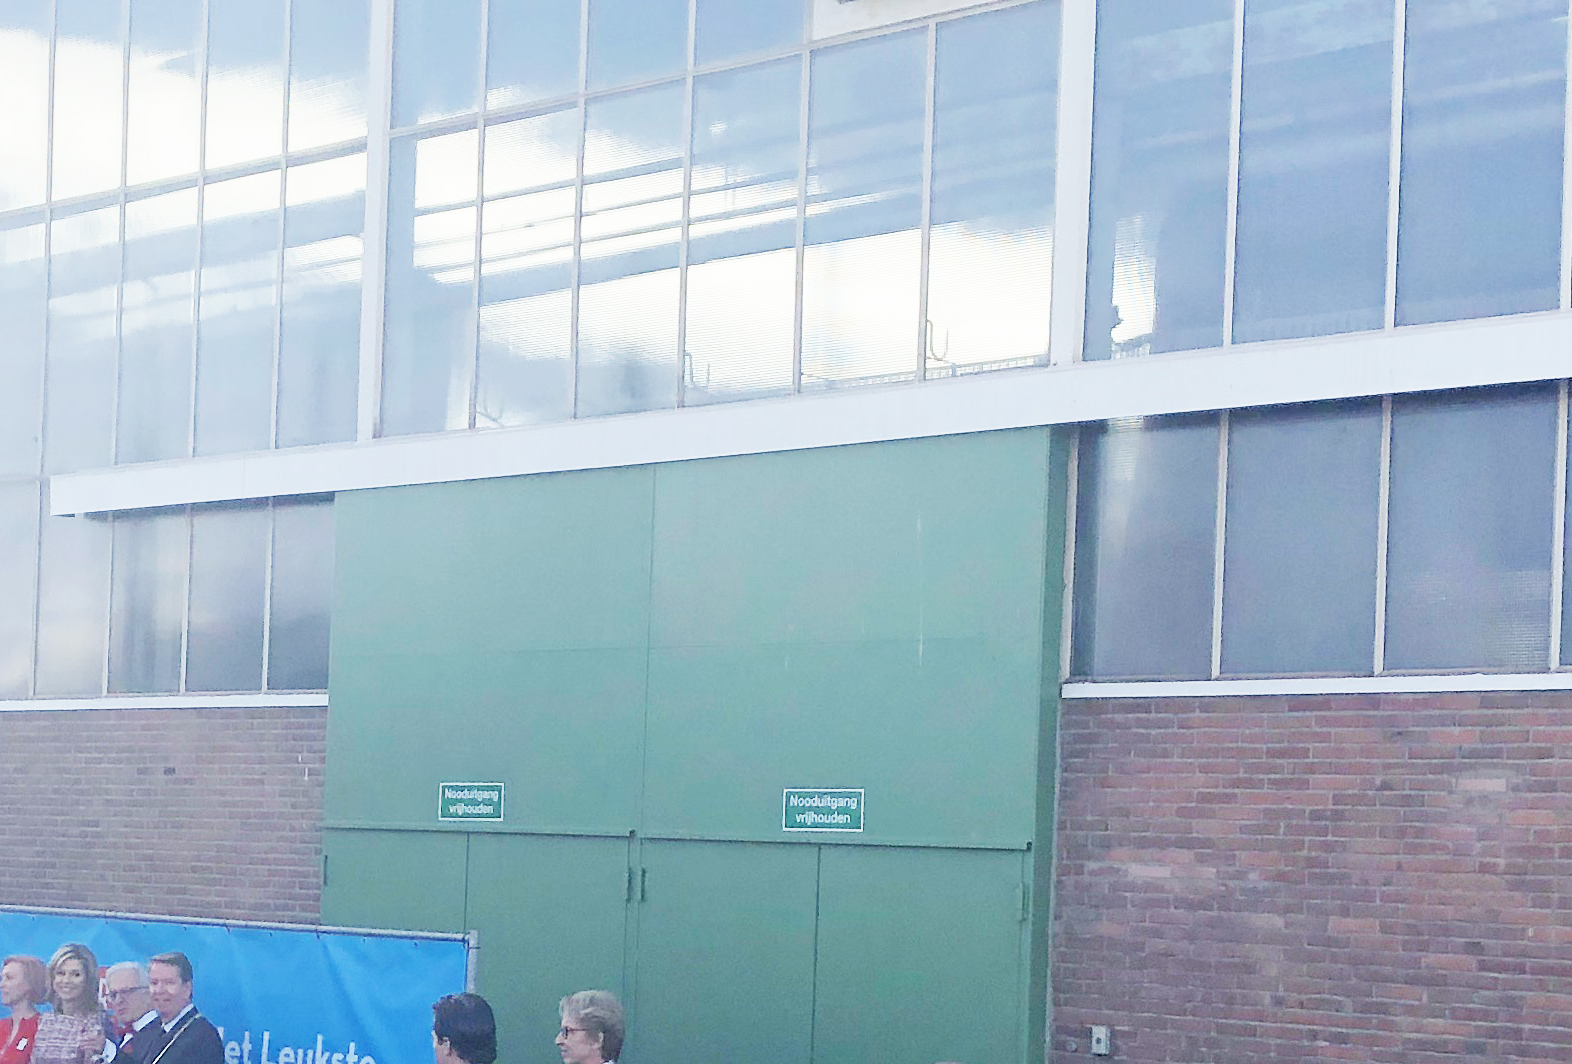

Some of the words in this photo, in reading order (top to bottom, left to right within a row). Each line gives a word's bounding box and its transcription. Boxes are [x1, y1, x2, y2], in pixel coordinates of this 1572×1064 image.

[444, 787, 499, 802] Nooduitgang
[448, 802, 494, 816] vrijhouden
[789, 794, 858, 810] Nooduitgang
[795, 811, 851, 825] vrijhouden
